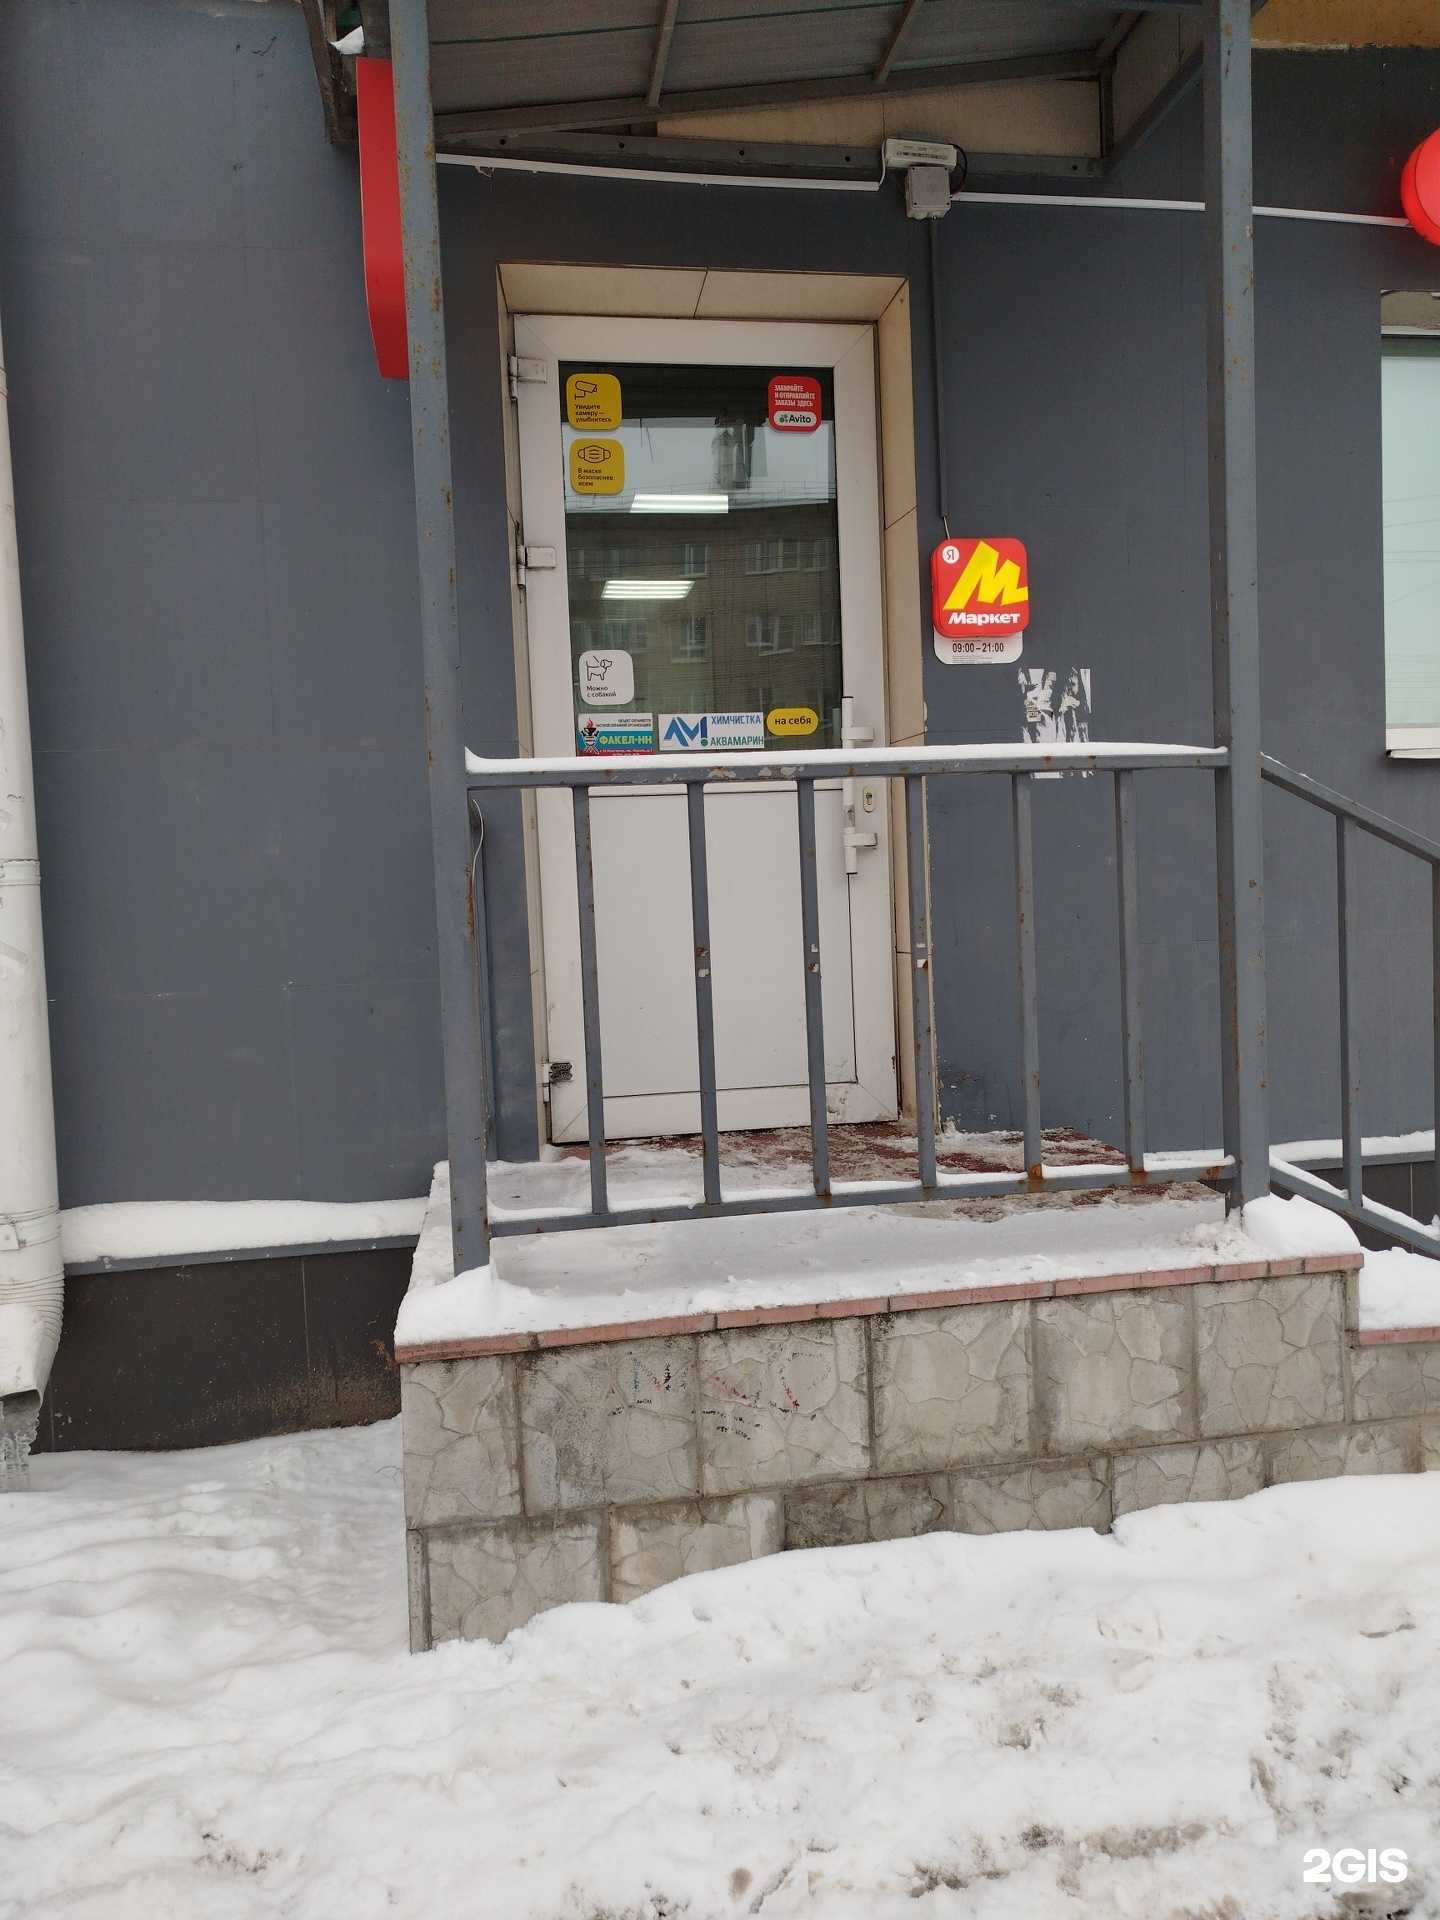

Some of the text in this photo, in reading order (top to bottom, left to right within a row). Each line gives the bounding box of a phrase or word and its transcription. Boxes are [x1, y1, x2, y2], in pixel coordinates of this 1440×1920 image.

[789, 414, 812, 423] Avito
[948, 612, 1021, 626] Маркет
[711, 715, 761, 725] ХИМЧИСТКА
[788, 715, 811, 725] себя
[710, 736, 763, 747] АКВАМАРИН
